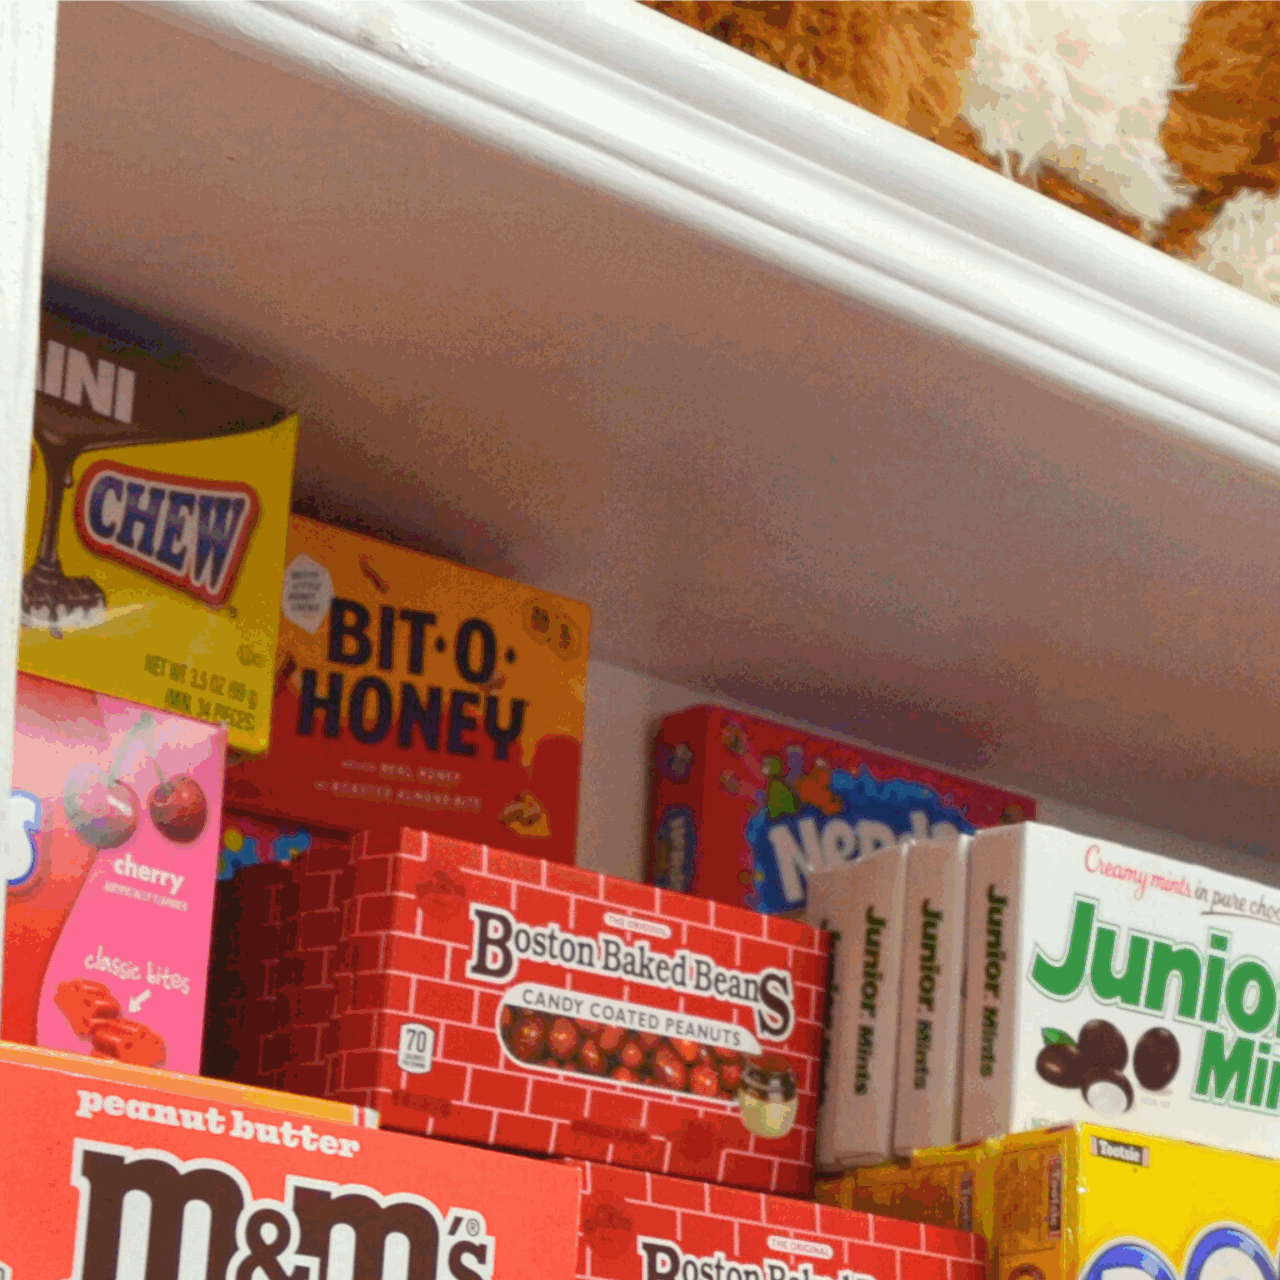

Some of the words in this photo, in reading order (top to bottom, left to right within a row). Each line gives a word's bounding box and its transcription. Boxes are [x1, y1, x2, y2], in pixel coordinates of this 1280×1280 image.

[36, 339, 136, 425] INI
[88, 473, 249, 594] CHEW
[297, 668, 527, 758] HONEY
[112, 852, 185, 896] cherry
[1084, 844, 1148, 901] Creamy
[1194, 880, 1208, 901] in
[1211, 889, 1248, 914] pure
[471, 909, 594, 978] Boston
[602, 937, 688, 987] Baked
[860, 904, 887, 1018] Junior
[917, 897, 943, 1013] Junior
[983, 883, 1009, 1000] Junior
[405, 1027, 428, 1053] 70
[521, 988, 585, 1016] CANDY
[589, 1003, 660, 1030] COATED
[664, 1016, 743, 1047] PEANUTS
[854, 1024, 874, 1096] Mints
[913, 1019, 932, 1090] Mints
[76, 1088, 227, 1136] peanut
[229, 1110, 361, 1159] butter
[1098, 1138, 1142, 1163] Tootsie
